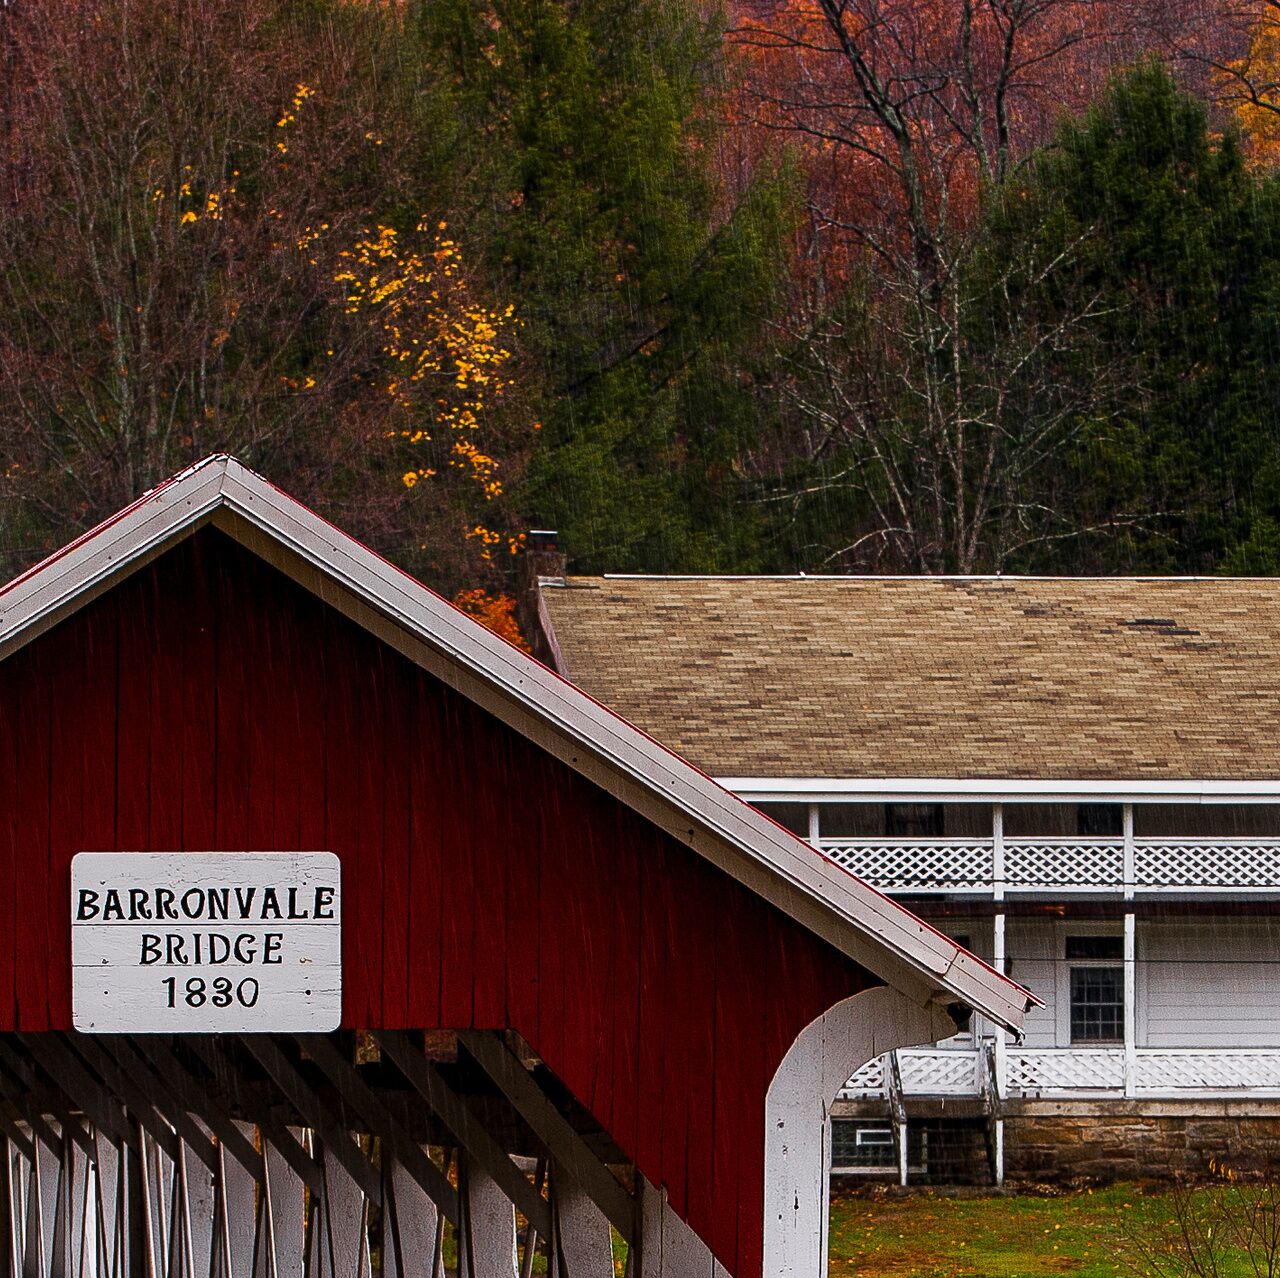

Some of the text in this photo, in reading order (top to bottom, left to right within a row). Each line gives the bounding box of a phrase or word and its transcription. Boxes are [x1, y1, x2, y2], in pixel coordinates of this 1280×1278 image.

[76, 887, 335, 921] BARRONVALE
[139, 933, 283, 966] BRIDGE
[161, 976, 259, 1008] 1830
